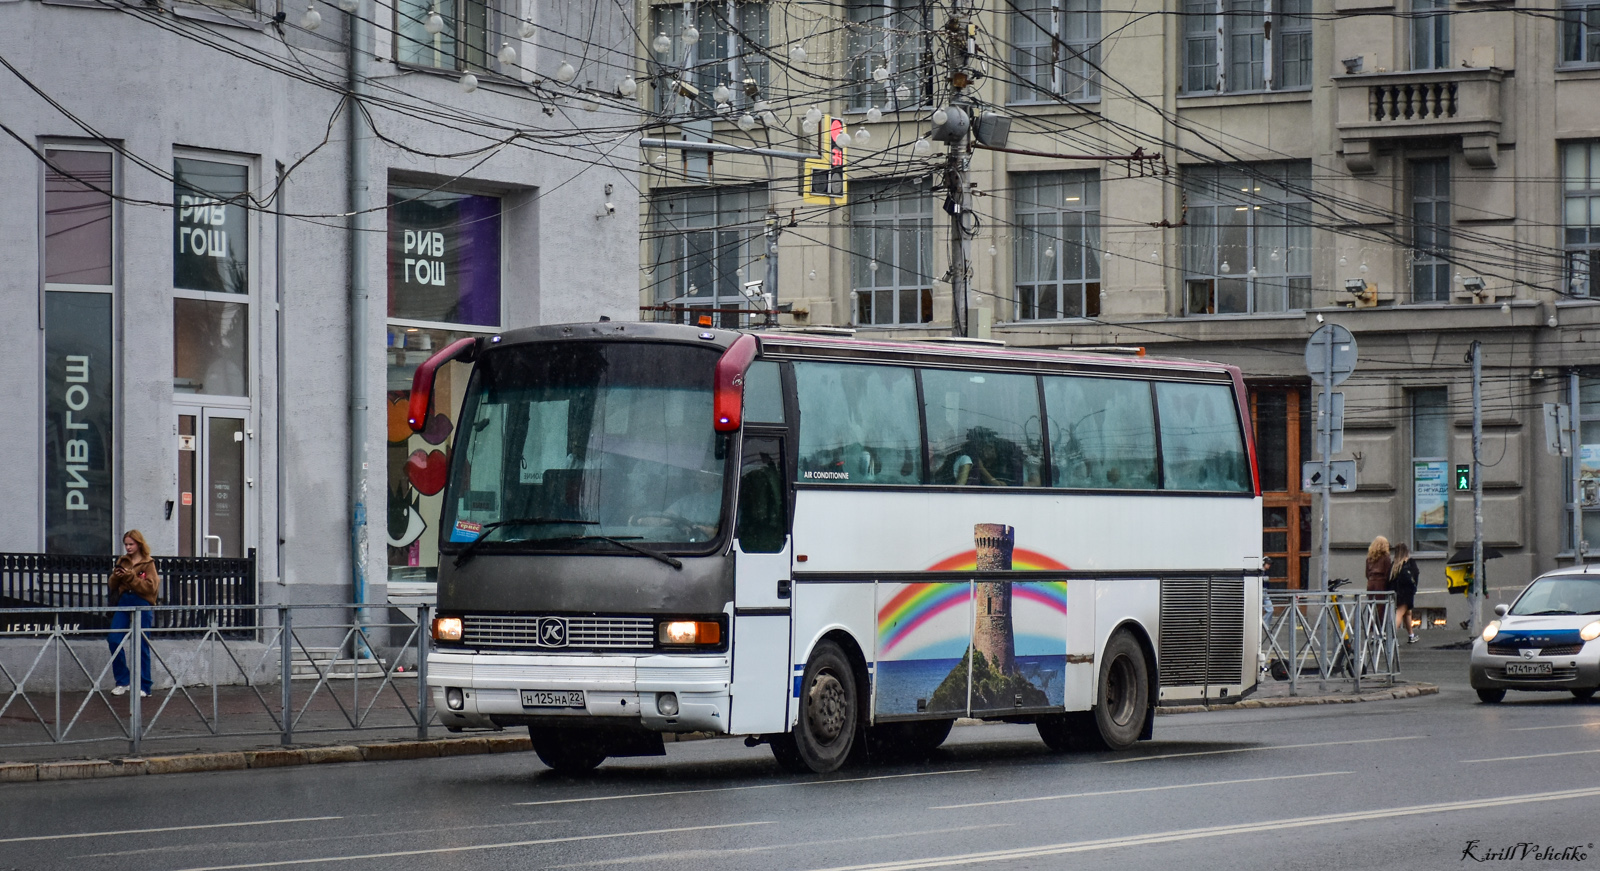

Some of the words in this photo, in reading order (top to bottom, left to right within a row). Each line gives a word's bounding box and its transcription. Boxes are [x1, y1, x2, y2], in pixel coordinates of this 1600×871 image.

[179, 195, 226, 226] РИВ
[180, 227, 226, 258] ГОШ
[404, 229, 445, 257] РИВ
[404, 258, 446, 287] ГОШ
[66, 355, 89, 430] ГОШ
[66, 439, 89, 511] РИВ
[804, 471, 813, 479] AIR
[813, 471, 849, 480] CONDITIONNE
